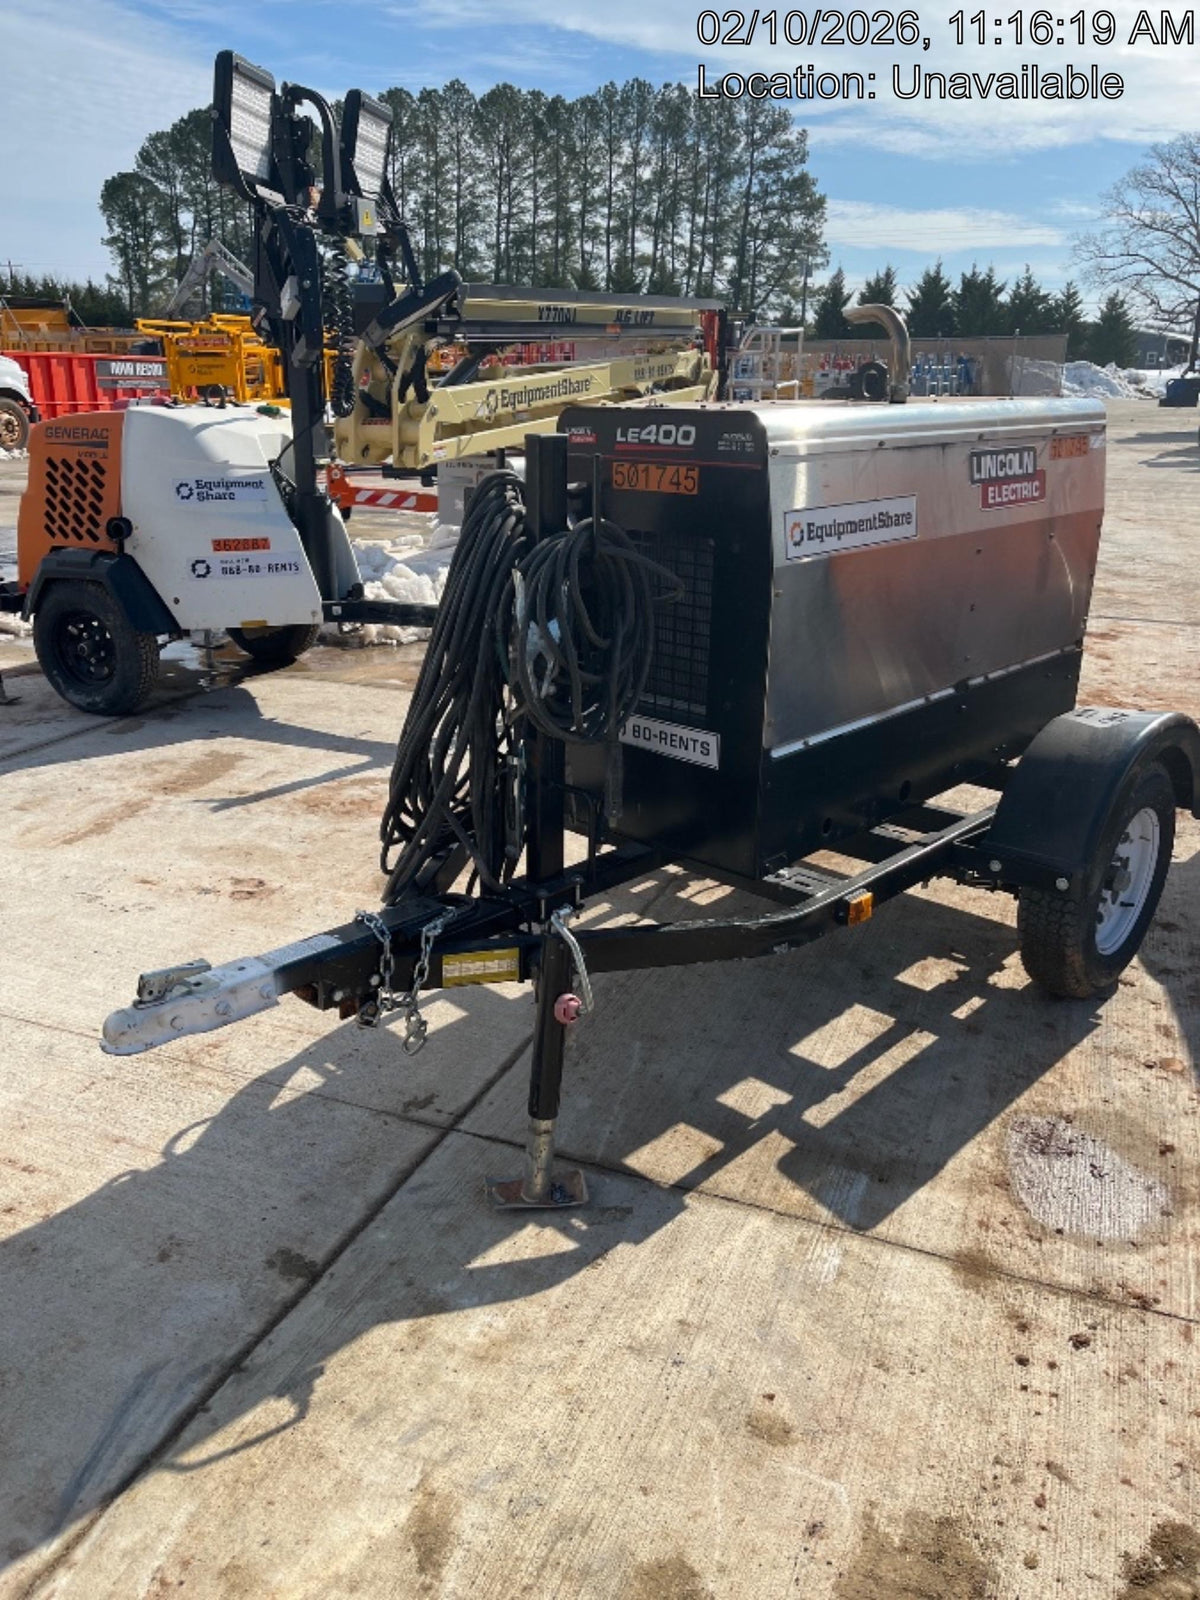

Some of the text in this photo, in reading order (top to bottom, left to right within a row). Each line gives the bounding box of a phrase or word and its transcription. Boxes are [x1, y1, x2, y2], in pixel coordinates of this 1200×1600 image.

[501, 377, 591, 409] EquipmentShare
[45, 426, 109, 440] GENERAC
[616, 424, 696, 446] LE400
[973, 451, 1034, 480] LINCOLN
[195, 479, 265, 491] Equipment
[613, 463, 697, 492] 501745
[196, 491, 236, 502] Share
[988, 481, 1039, 504] ELECTRIC
[806, 511, 913, 542] EquipmentShare
